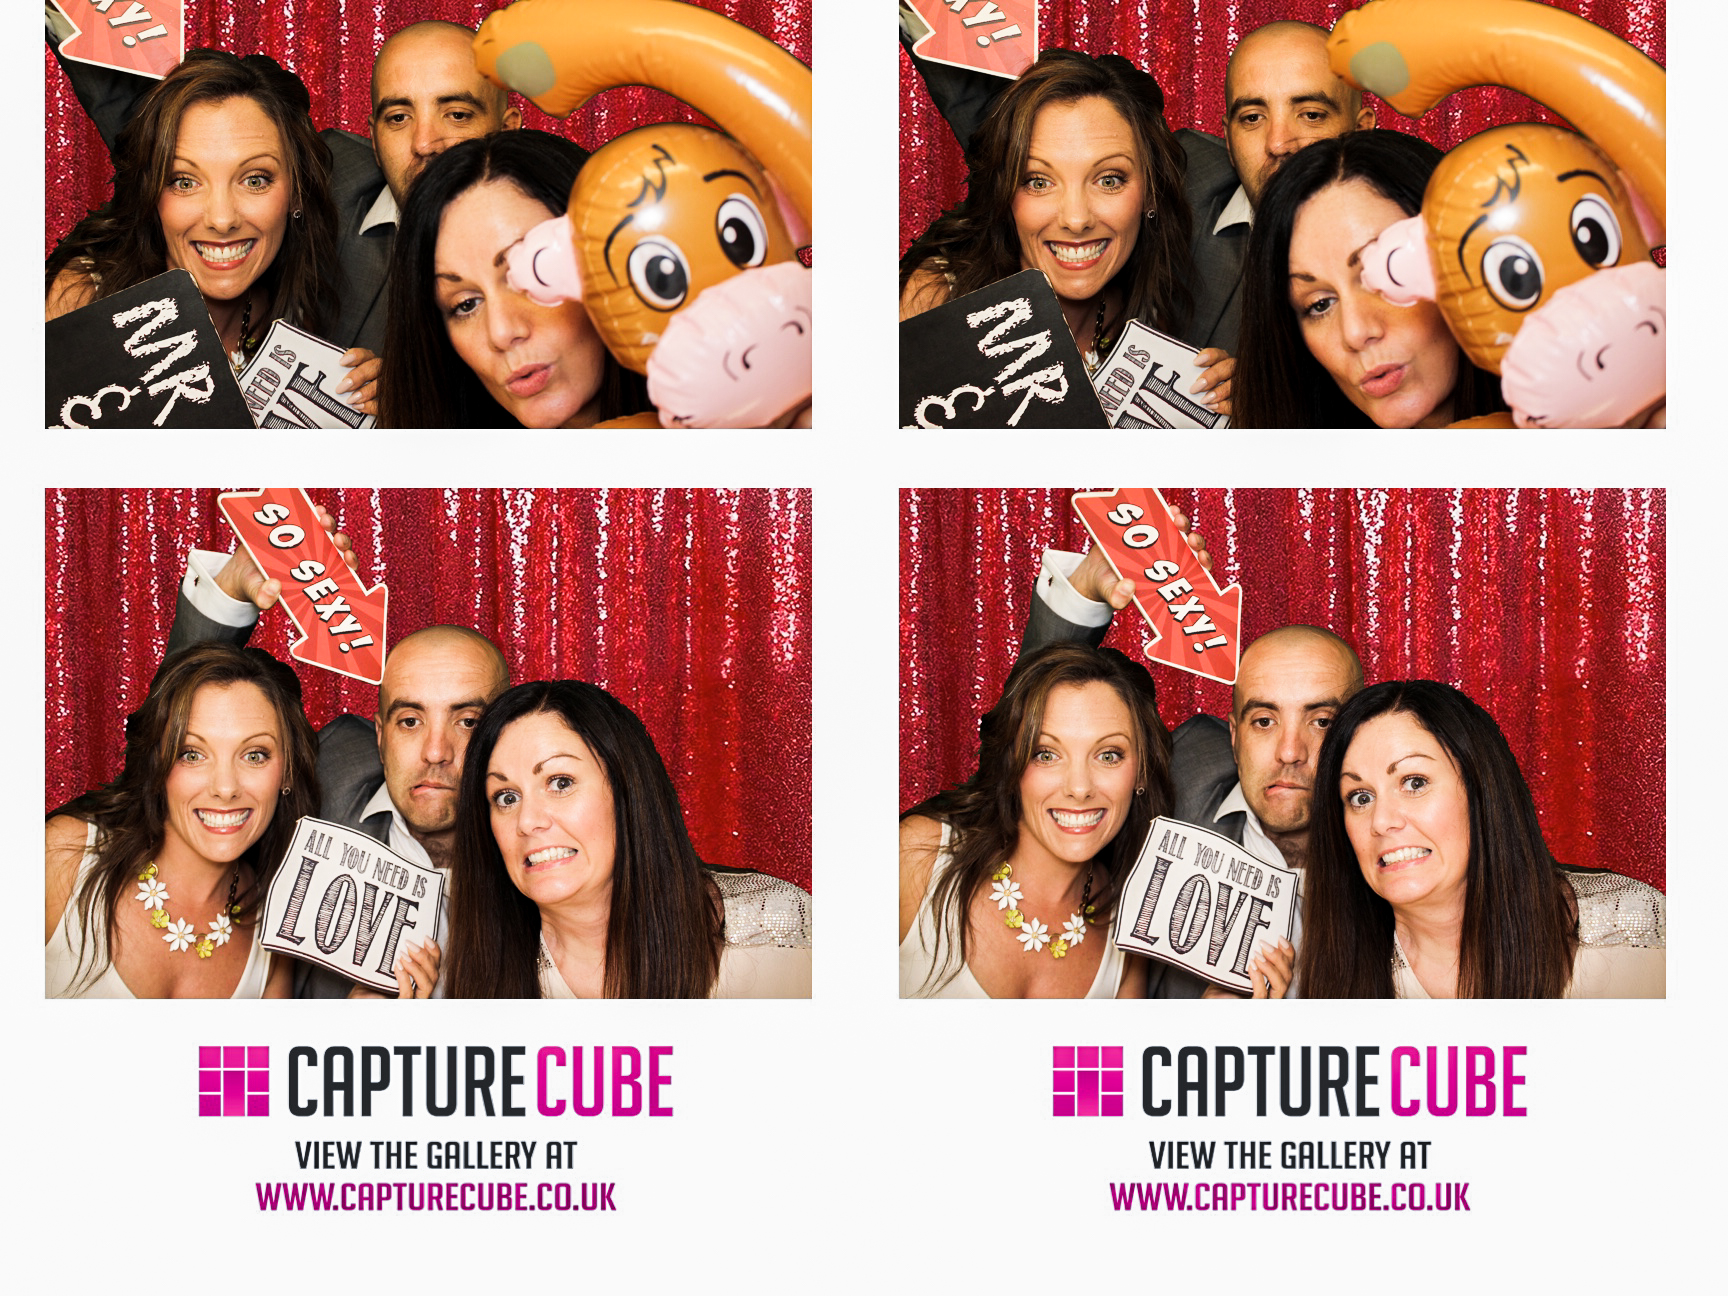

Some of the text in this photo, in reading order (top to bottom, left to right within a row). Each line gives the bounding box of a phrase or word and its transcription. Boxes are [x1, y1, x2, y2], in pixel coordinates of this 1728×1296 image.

[112, 297, 215, 427] MR
[269, 344, 297, 370] IS
[966, 297, 1069, 427] MR
[1123, 344, 1151, 370] IS
[253, 503, 374, 654] SO SEXY!
[1107, 503, 1228, 654] SO SEXY!
[276, 855, 419, 981] LOVE
[304, 829, 428, 899] ALL YOU NEED IS
[1130, 855, 1273, 981] LOVE
[1158, 829, 1282, 899] ALL YOU NEED IS
